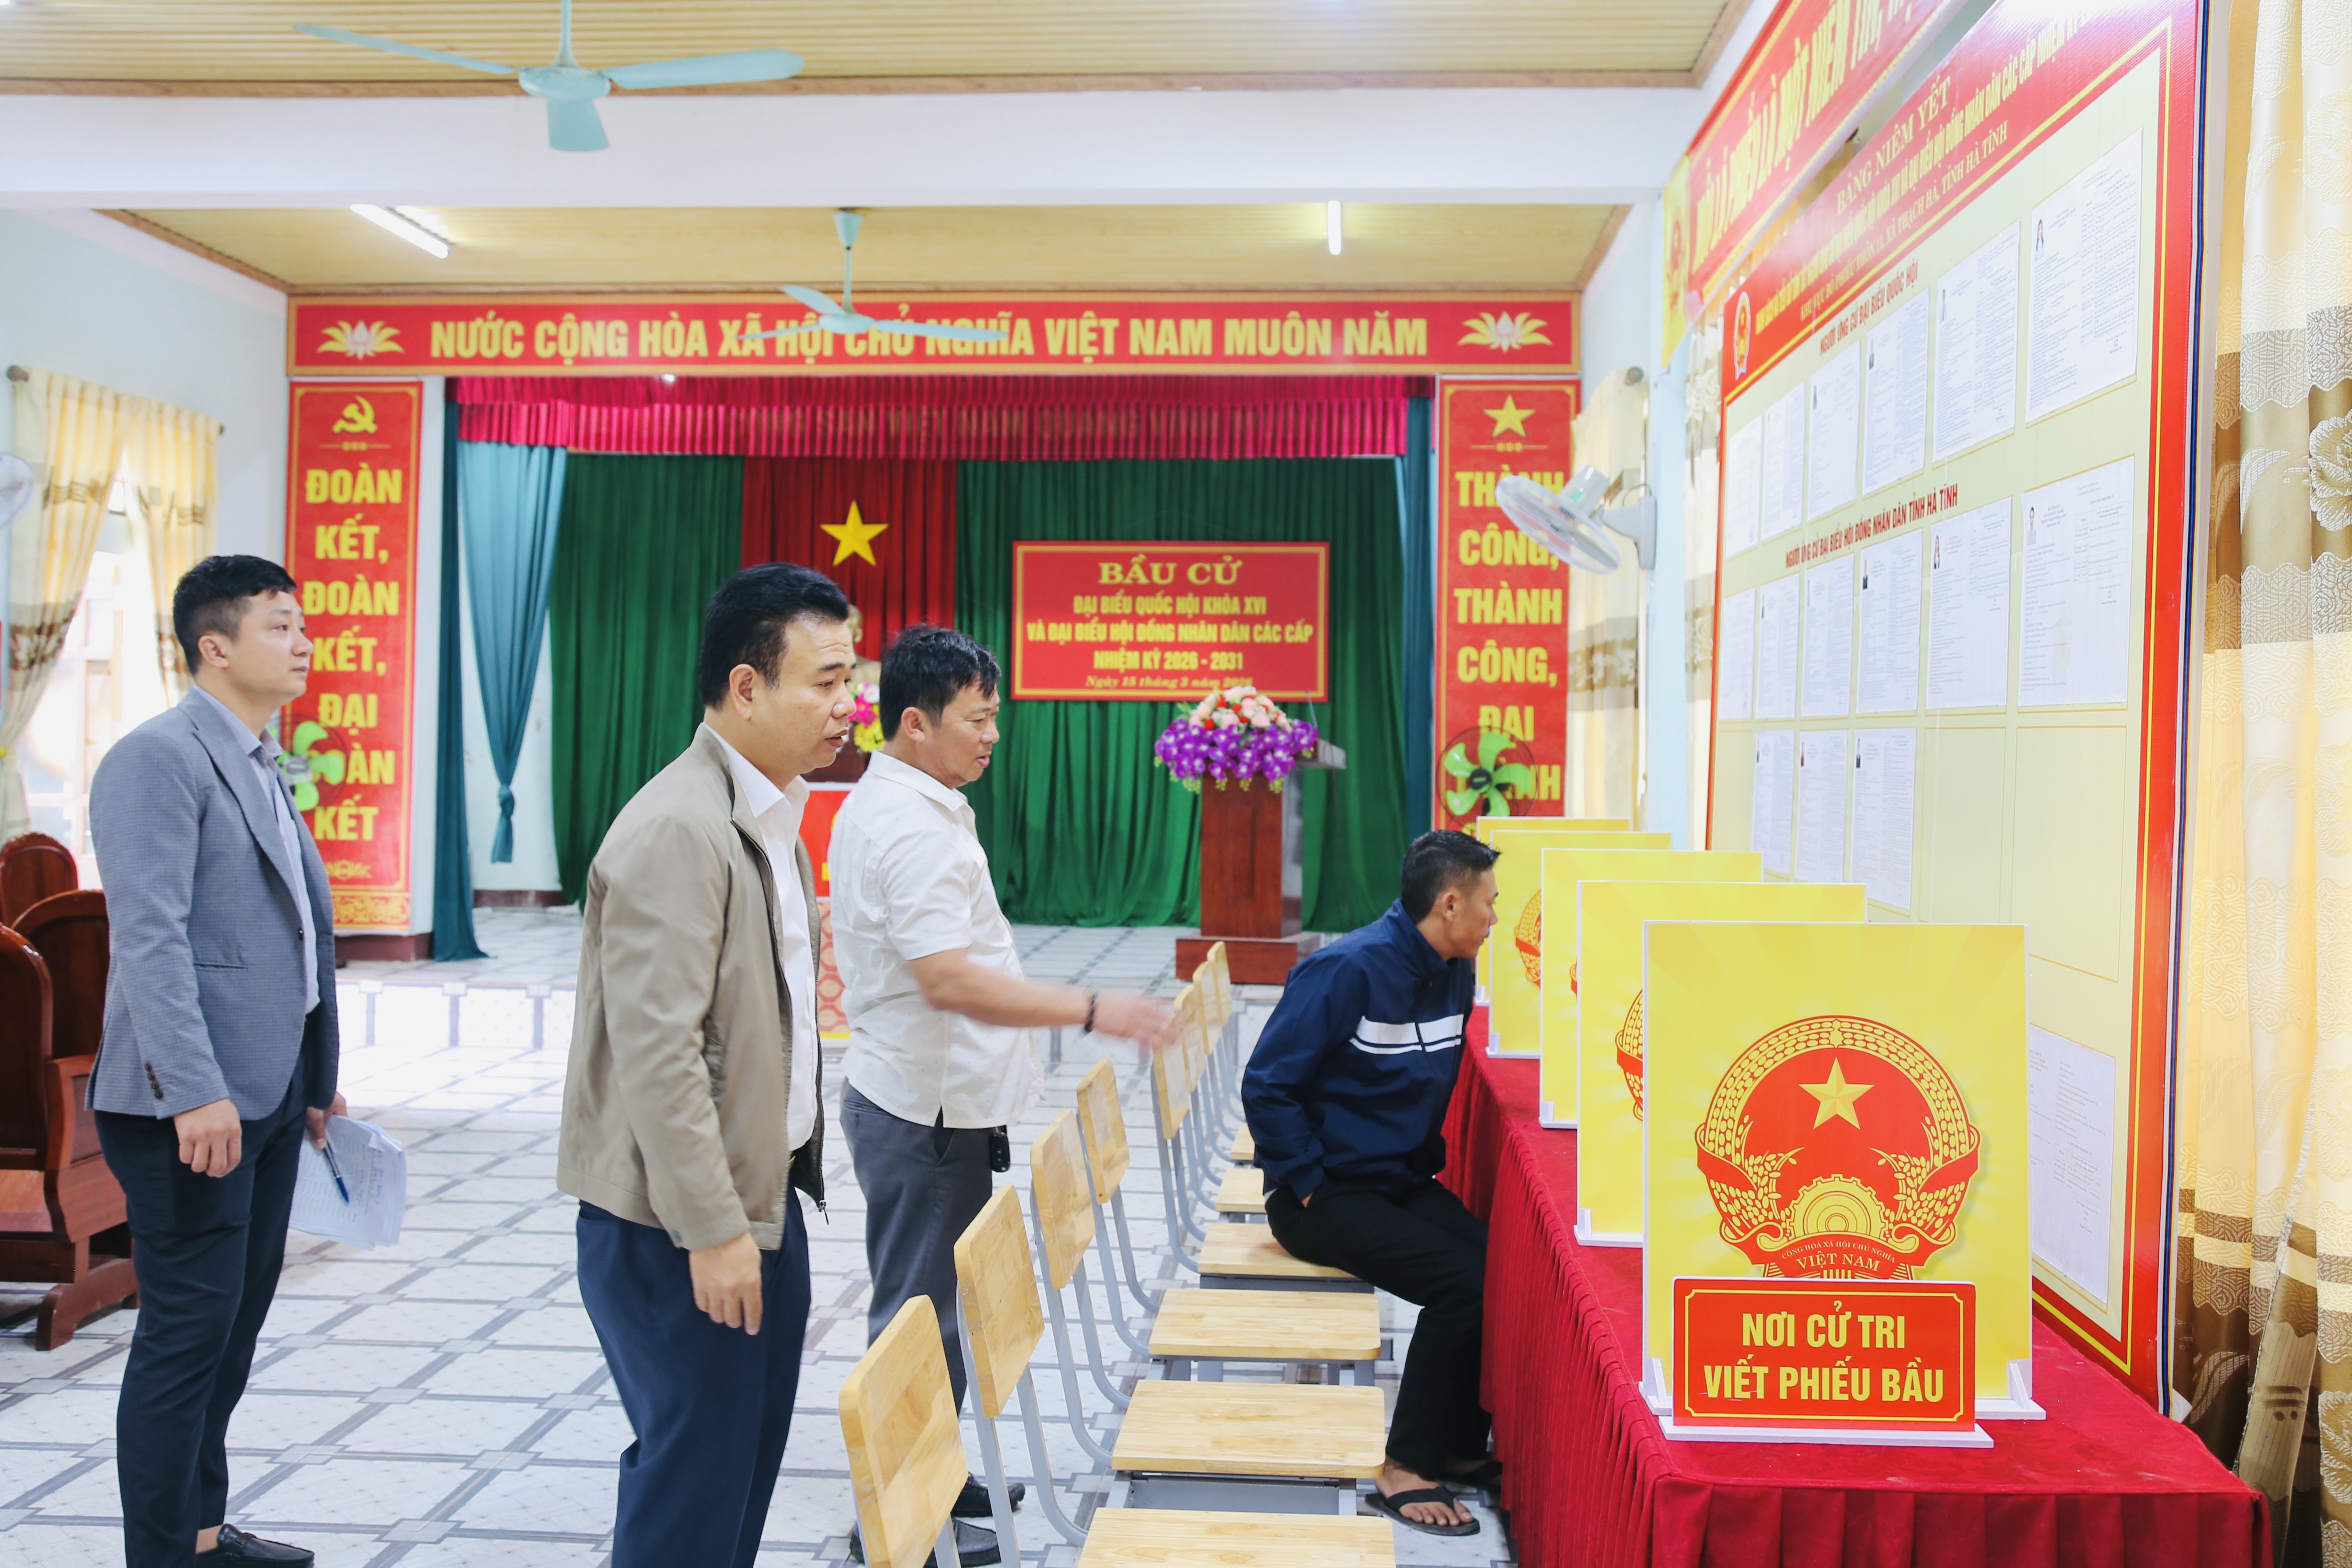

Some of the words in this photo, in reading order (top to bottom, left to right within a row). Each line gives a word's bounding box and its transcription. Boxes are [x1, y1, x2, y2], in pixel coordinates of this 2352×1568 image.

[1965, 86, 1984, 137] NHÂN
[1985, 70, 2001, 118] DÂN
[2002, 53, 2018, 102] CÁC
[1837, 162, 1872, 216] BẢNG
[1875, 114, 1914, 176] NIÊM
[1917, 74, 1951, 131] YẾT
[1966, 139, 1979, 176] HÀ
[1982, 118, 2008, 162] TĨNH
[430, 310, 525, 359] NƯỚC
[534, 313, 628, 365] CỘNG
[638, 310, 708, 358] HÒA
[718, 312, 766, 357] XÃ
[775, 312, 835, 364] HỘI
[1044, 311, 1120, 364] VIỆT
[1130, 317, 1213, 357] NAM
[1224, 310, 1332, 357] MUÔN
[1343, 310, 1428, 357] NĂM
[305, 462, 403, 504] ĐOÀN
[1873, 508, 1890, 536] NHÂN
[1892, 502, 1906, 528] DÂN
[1909, 492, 1926, 523] TỈNH
[1927, 487, 1937, 516] HÀ
[1940, 483, 1958, 512] TĨNH
[315, 513, 389, 564] KẾT,
[1187, 555, 1243, 585] CỬ
[302, 574, 399, 616] ĐOÀN
[1073, 595, 1098, 618] ĐẠI
[1100, 588, 1133, 615] BIỂU
[1135, 590, 1173, 615] QUỐC
[1176, 592, 1200, 618] HỘI
[1203, 592, 1241, 615] KHÓA
[1244, 596, 1267, 615] XVI
[1454, 581, 1563, 625] THÀNH
[312, 626, 387, 676] KẾT,
[1026, 619, 1047, 642] VÀ
[1048, 623, 1072, 645] ĐẠI
[1074, 616, 1107, 642] BIỂU
[1109, 620, 1134, 647] HỘI
[1136, 617, 1176, 643] ĐỒNG
[1178, 620, 1218, 643] NHÂN
[1220, 620, 1250, 643] DÂN
[1253, 619, 1282, 643] CÁC
[1284, 618, 1314, 644] CẤP
[1085, 675, 1119, 688] Ngày
[1139, 675, 1178, 689] tháng
[1093, 647, 1140, 674] NHIỆM
[1142, 647, 1161, 670] KỲ
[1163, 651, 1199, 670] 2026
[1209, 651, 1244, 670] 2031
[1457, 640, 1558, 688] CÔNG,
[318, 693, 378, 736] ĐẠI
[307, 742, 395, 785] ÀN
[313, 794, 379, 841] KẾT
[1781, 1247, 1803, 1259] CỘNG
[1804, 1241, 1822, 1251] HOÀ
[1836, 1240, 1851, 1248] HỘI
[1852, 1241, 1870, 1251] CHỦ
[1871, 1247, 1896, 1263] NGHĨA
[1796, 1250, 1837, 1269] VIỆT
[1842, 1253, 1881, 1271] NAM
[1742, 1313, 1796, 1348] NƠI
[1806, 1300, 1852, 1349] CỬ
[1858, 1314, 1906, 1349] TRI
[1703, 1351, 1769, 1400] VIẾT
[1779, 1355, 1871, 1403] PHIẾU
[1882, 1357, 1944, 1403] BẦU
